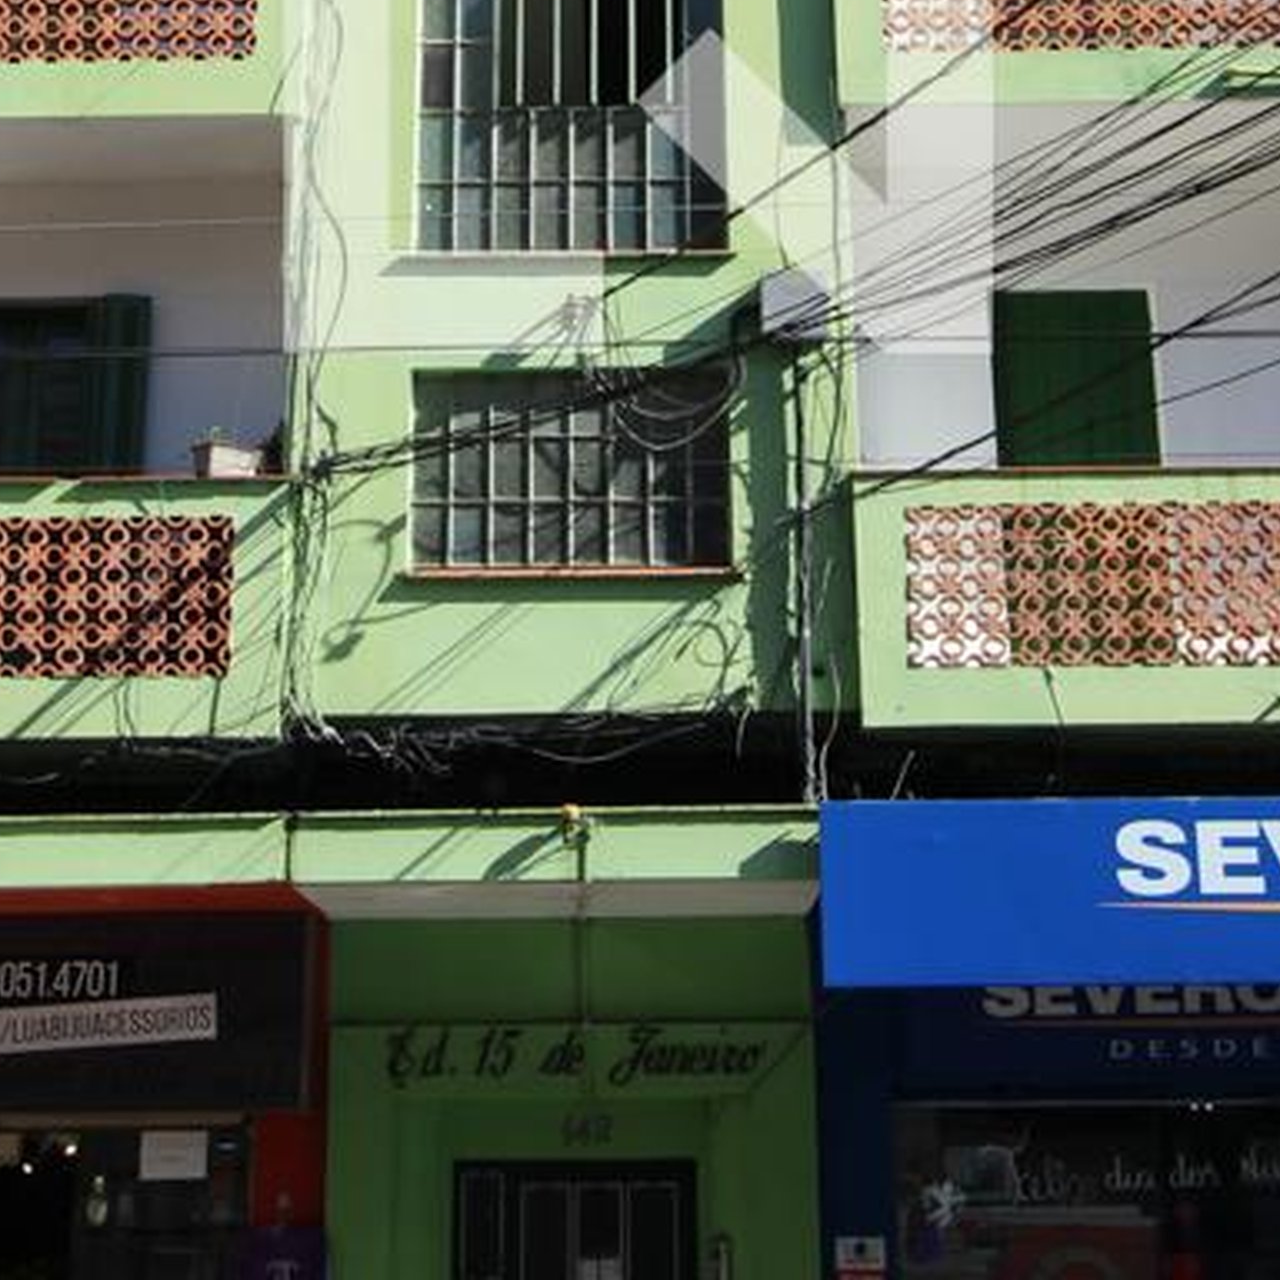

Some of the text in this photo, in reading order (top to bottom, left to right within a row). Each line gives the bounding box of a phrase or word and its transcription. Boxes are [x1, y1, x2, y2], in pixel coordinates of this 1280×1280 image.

[386, 1023, 770, 1089] Ed. 15 de Janeiro
[1108, 1036, 1272, 1061] DESDE
